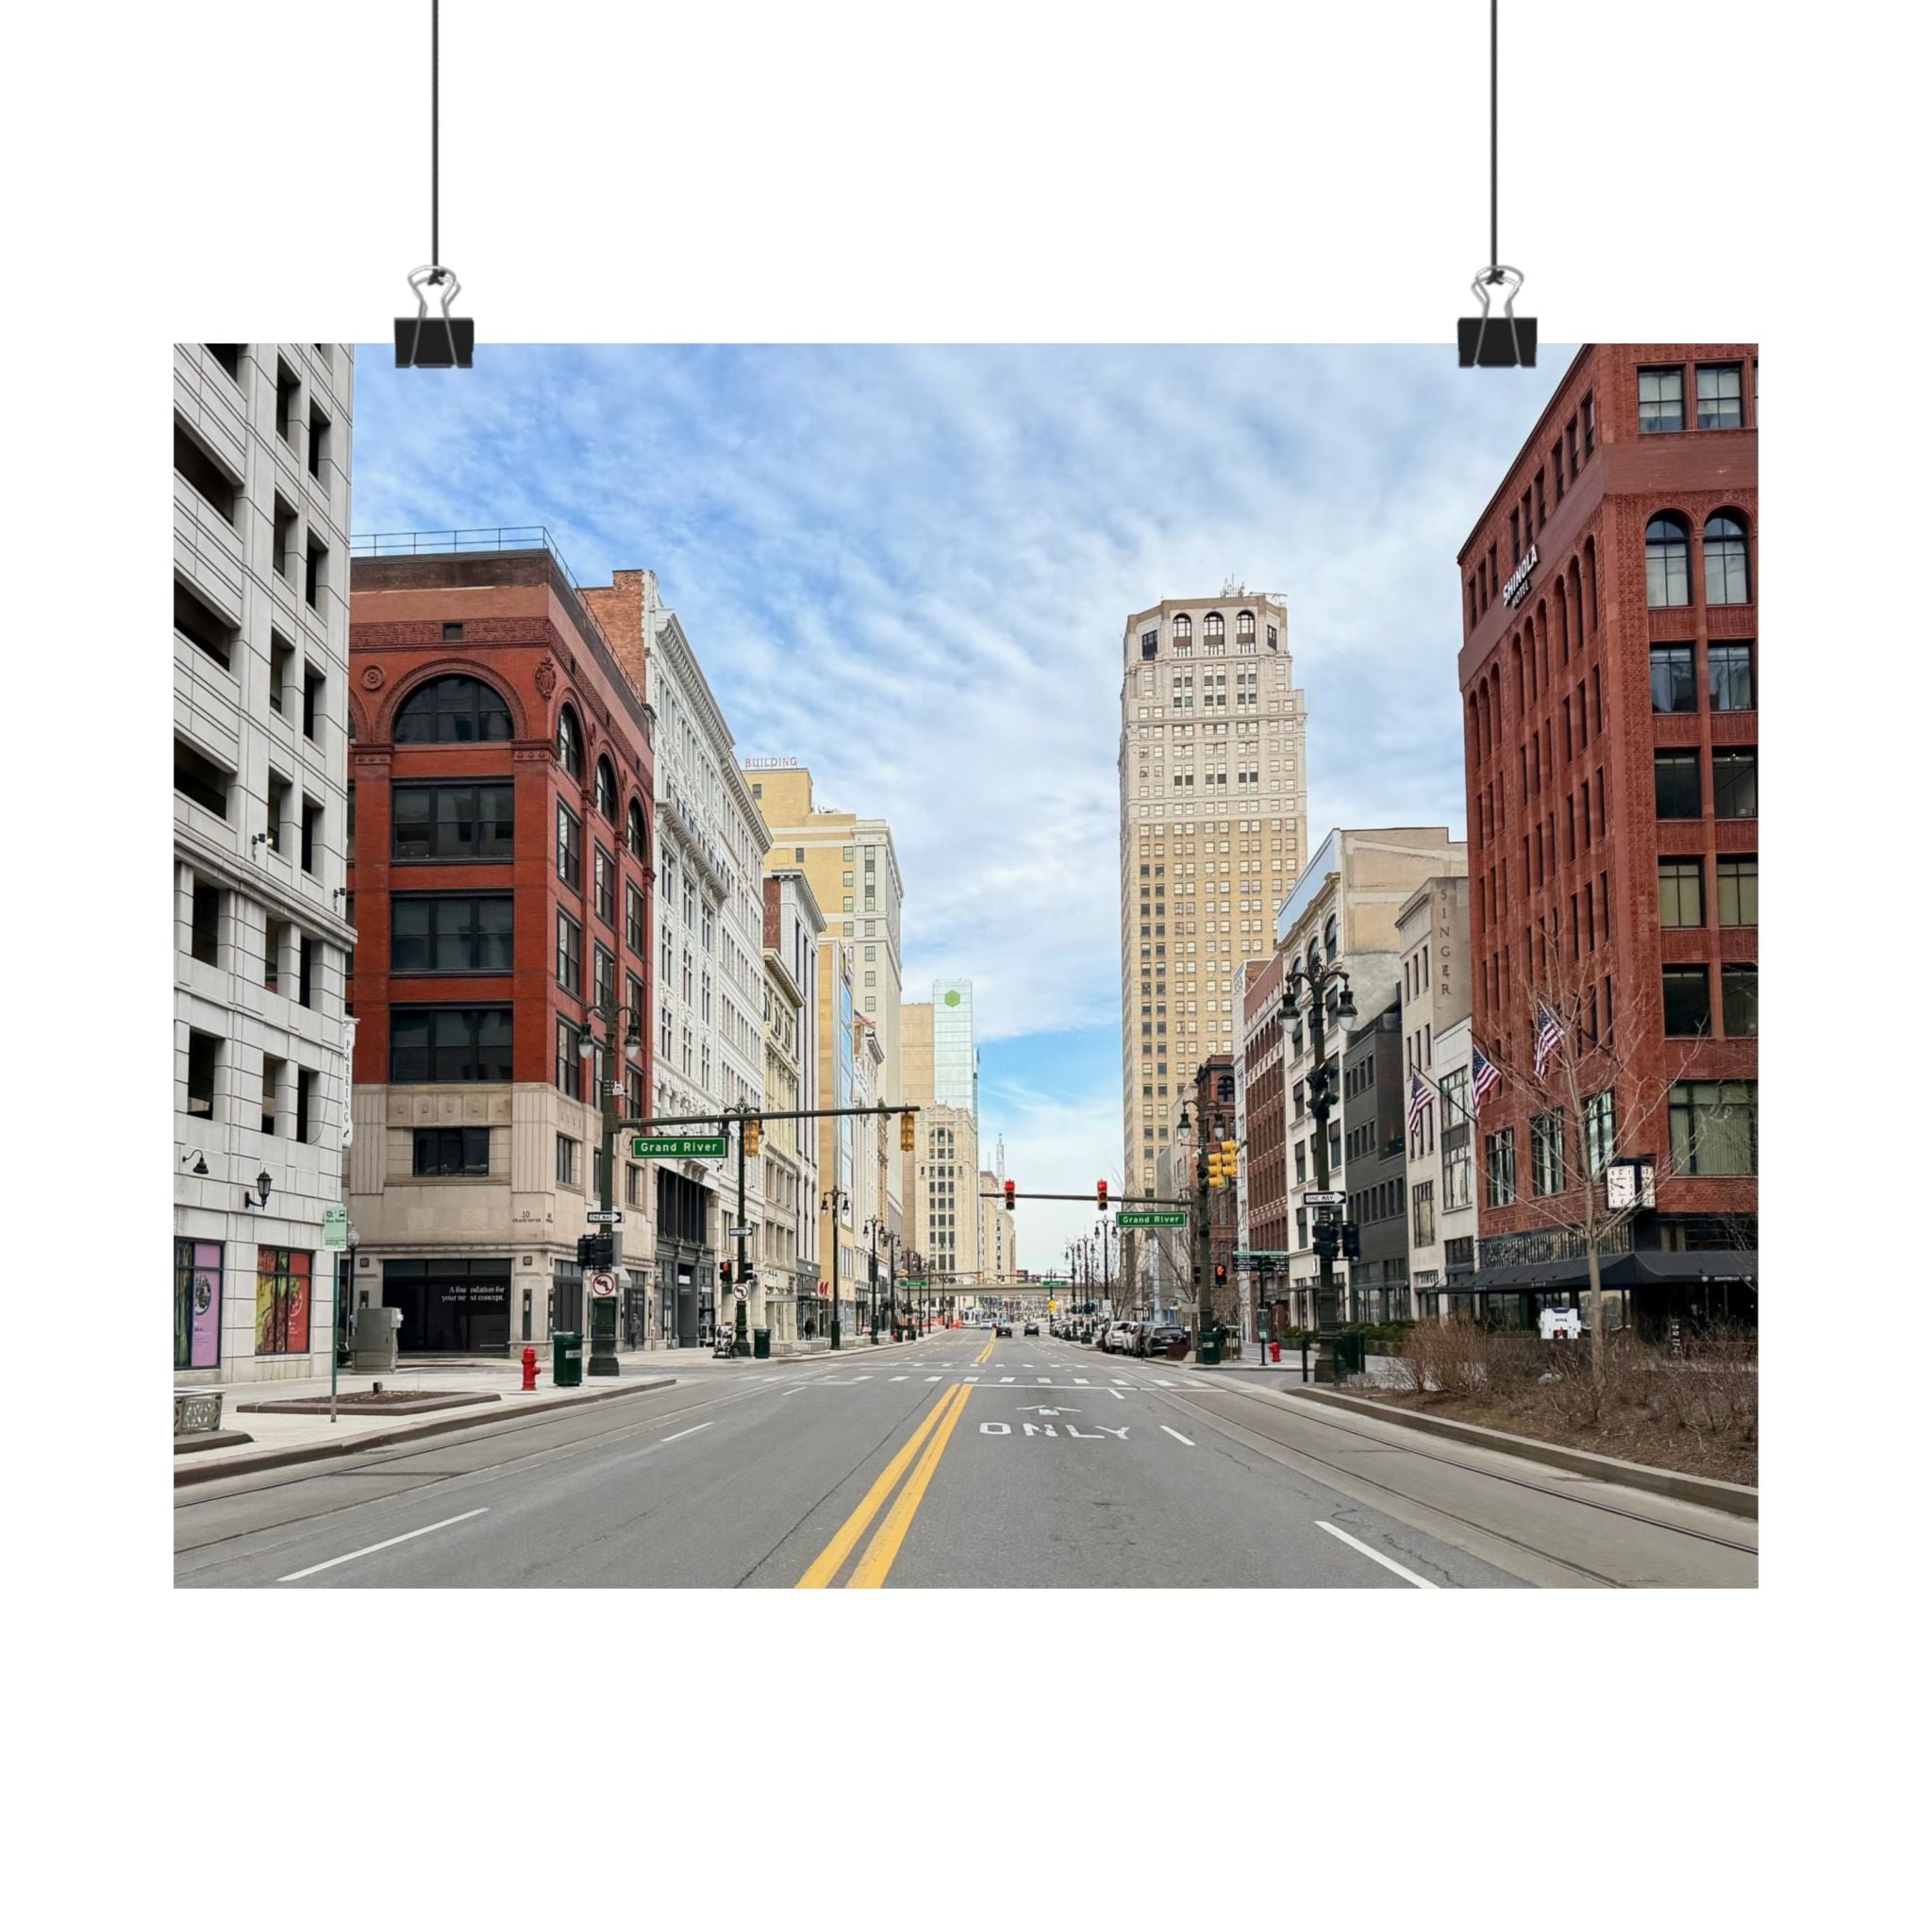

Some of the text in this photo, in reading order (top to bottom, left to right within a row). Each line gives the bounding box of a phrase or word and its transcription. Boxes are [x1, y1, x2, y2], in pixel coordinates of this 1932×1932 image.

[1503, 543, 1538, 607] SHINOLA
[1512, 579, 1529, 608] HOTEL
[745, 757, 797, 768] BUILDING
[1440, 889, 1452, 995] SINGER
[641, 1141, 717, 1152] Grand River
[441, 1294, 457, 1303] your
[979, 1422, 1130, 1440] ONLY
